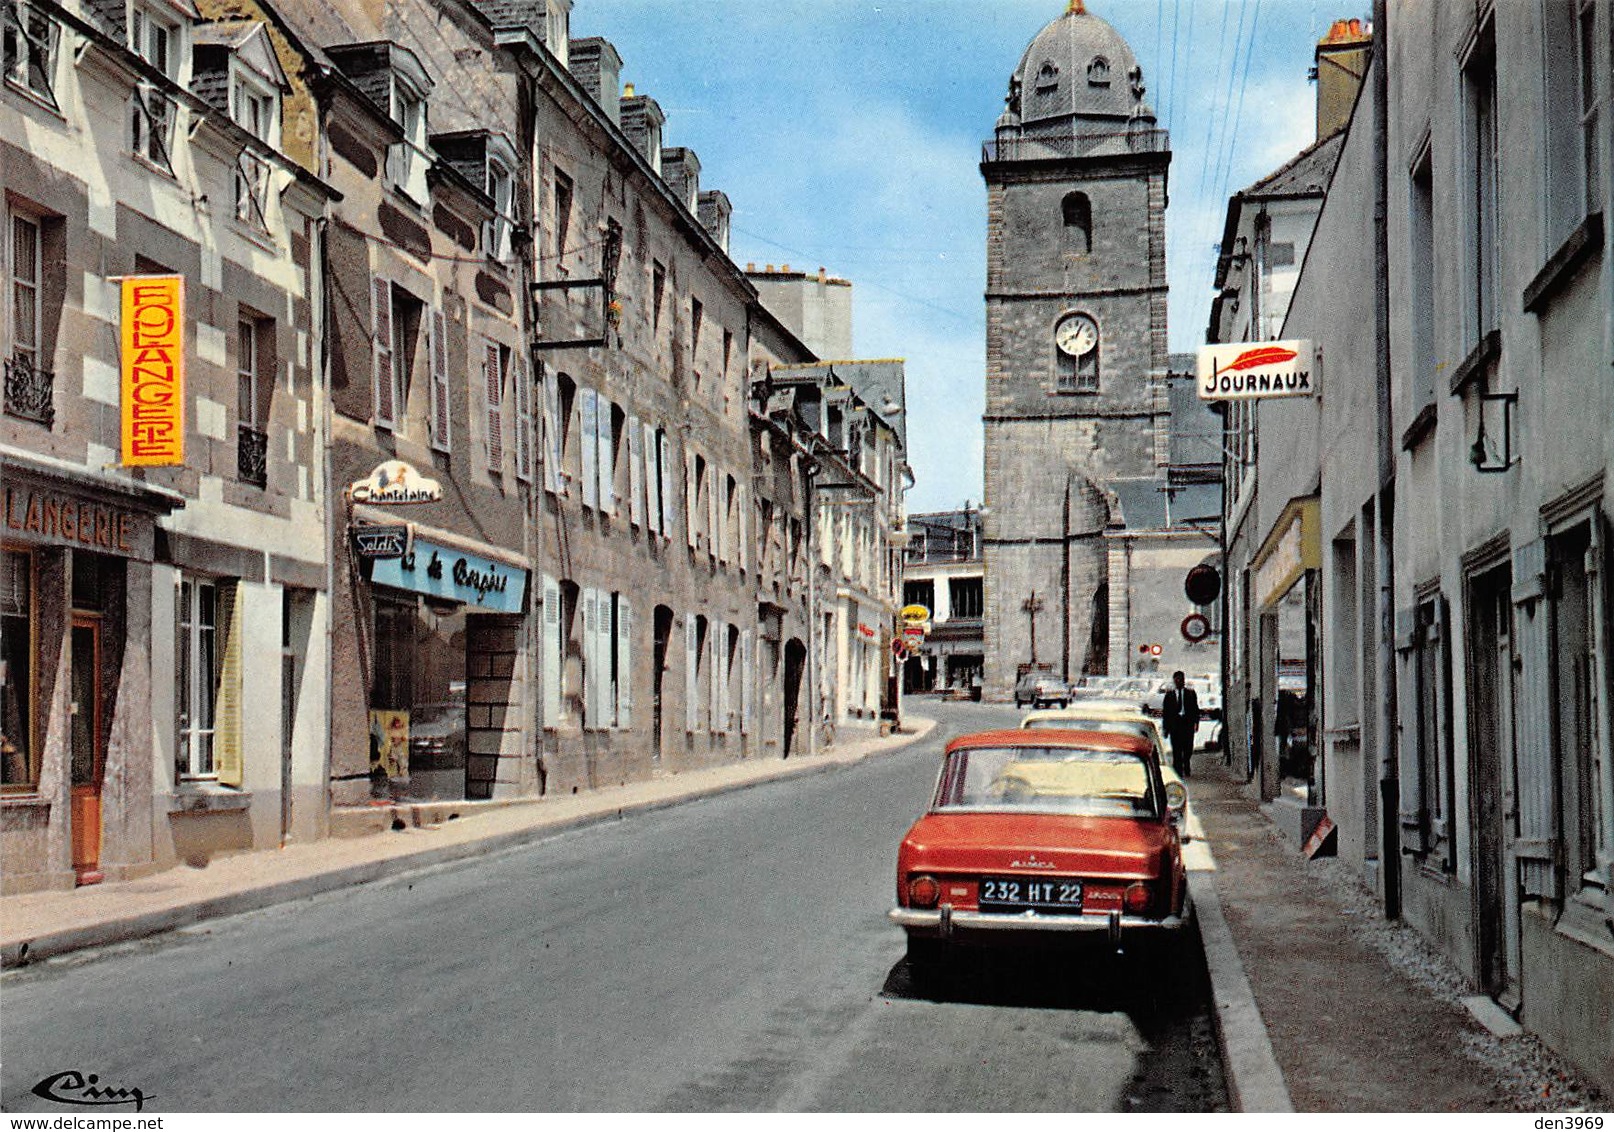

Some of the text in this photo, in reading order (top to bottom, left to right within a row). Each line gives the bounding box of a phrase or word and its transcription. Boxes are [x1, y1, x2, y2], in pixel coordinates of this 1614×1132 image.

[1205, 356, 1310, 393] JOURNAUX
[984, 880, 1020, 901] 232
[1028, 882, 1054, 903] HT
[1059, 884, 1081, 903] 22
